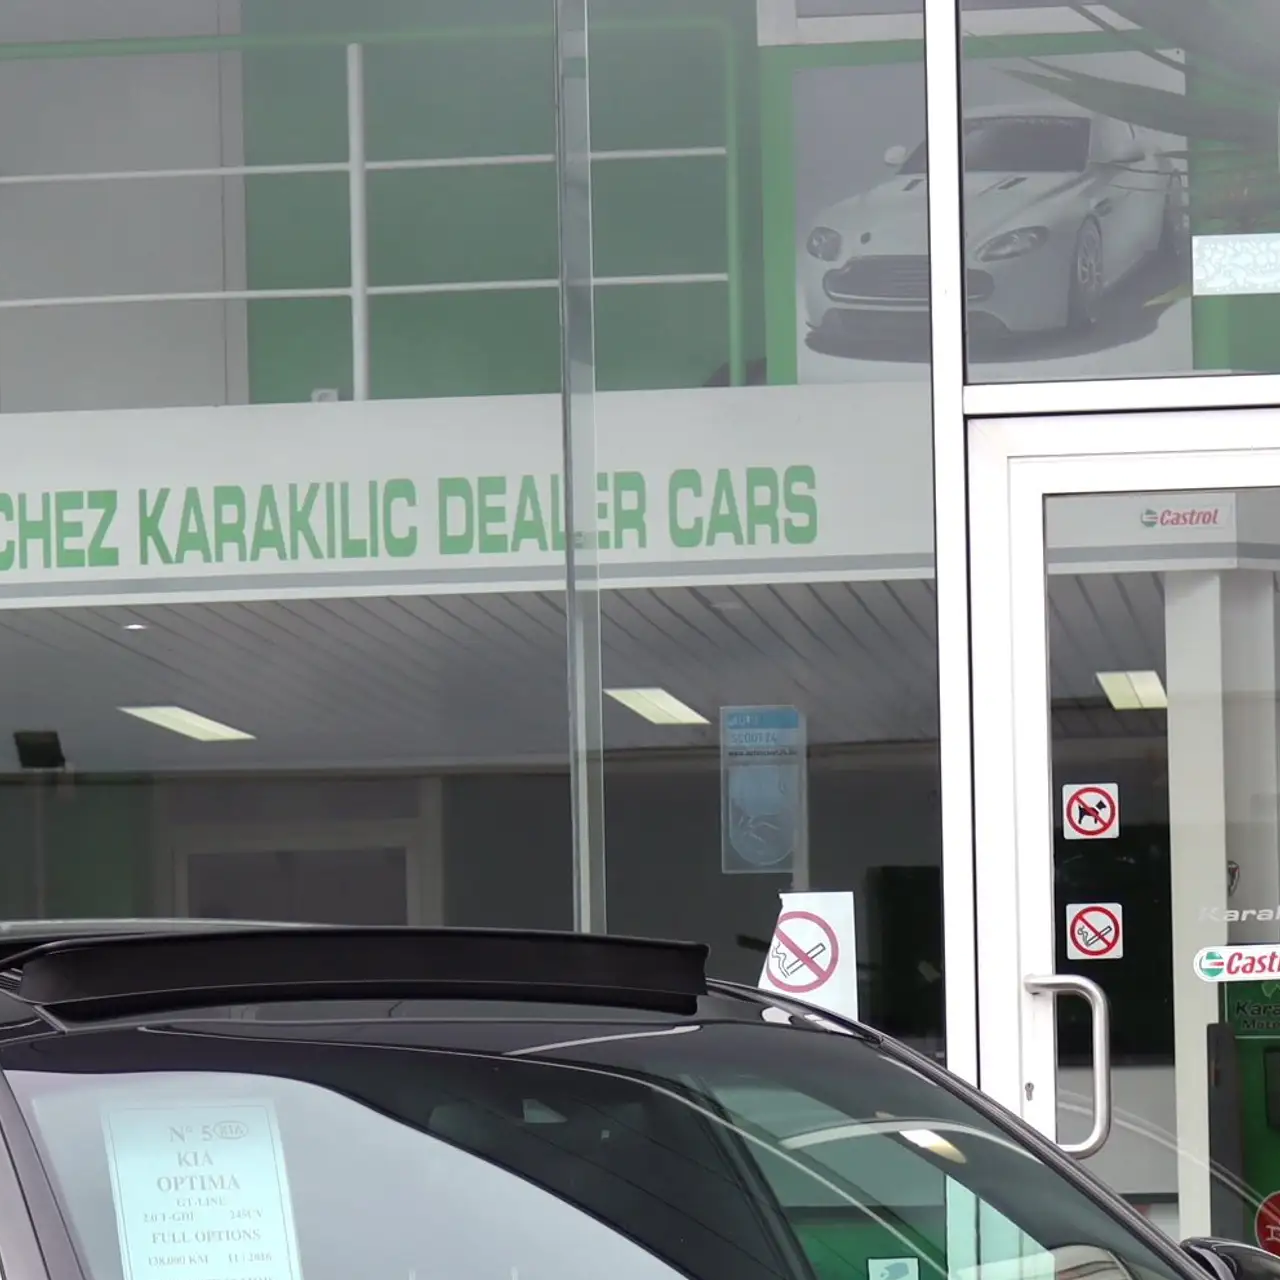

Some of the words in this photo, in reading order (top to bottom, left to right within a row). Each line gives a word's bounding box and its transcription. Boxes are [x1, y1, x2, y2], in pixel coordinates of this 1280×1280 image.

[137, 477, 418, 566] KARAKILIC
[667, 464, 818, 548] CARS
[1160, 508, 1219, 526] Castrol
[176, 1149, 214, 1168] KIA
[156, 1173, 241, 1193] OPTIMA
[152, 1230, 192, 1245] FULL
[194, 1227, 262, 1243] OPTIONS
